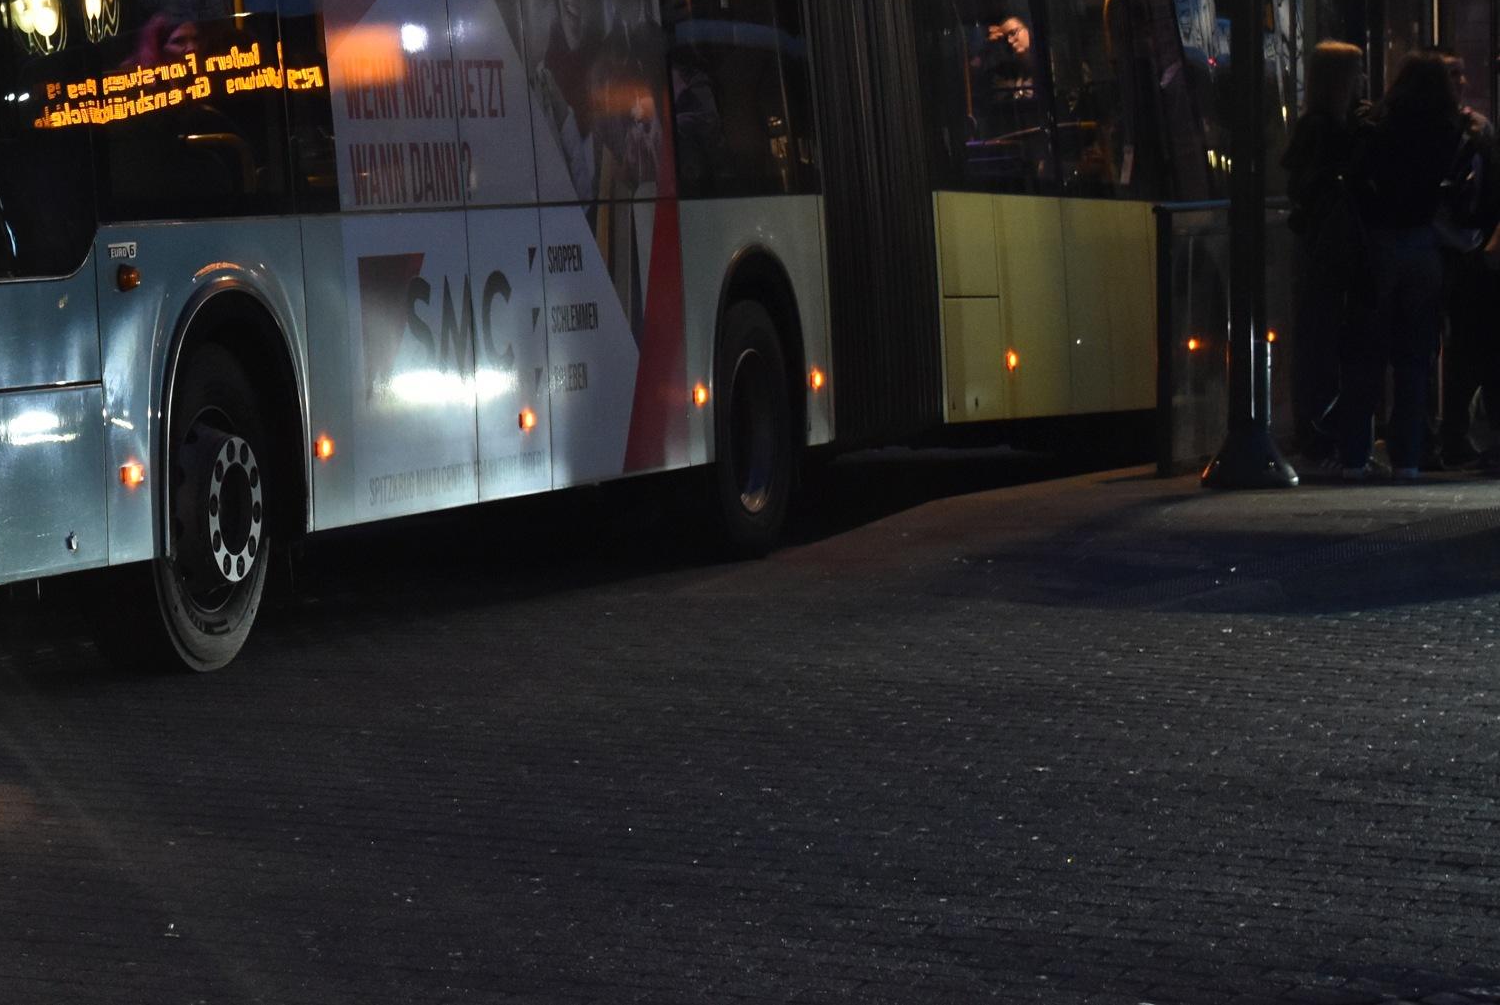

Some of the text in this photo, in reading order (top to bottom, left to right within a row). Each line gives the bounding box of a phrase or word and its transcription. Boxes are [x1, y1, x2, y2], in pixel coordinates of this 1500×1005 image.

[341, 59, 505, 120] WENN NICHT JETZT
[350, 143, 407, 206] WANN
[110, 244, 136, 258] EURO 6
[547, 245, 583, 274] SHOPPEN
[406, 270, 515, 378] SMC
[551, 302, 598, 334] SCHLEMMEN
